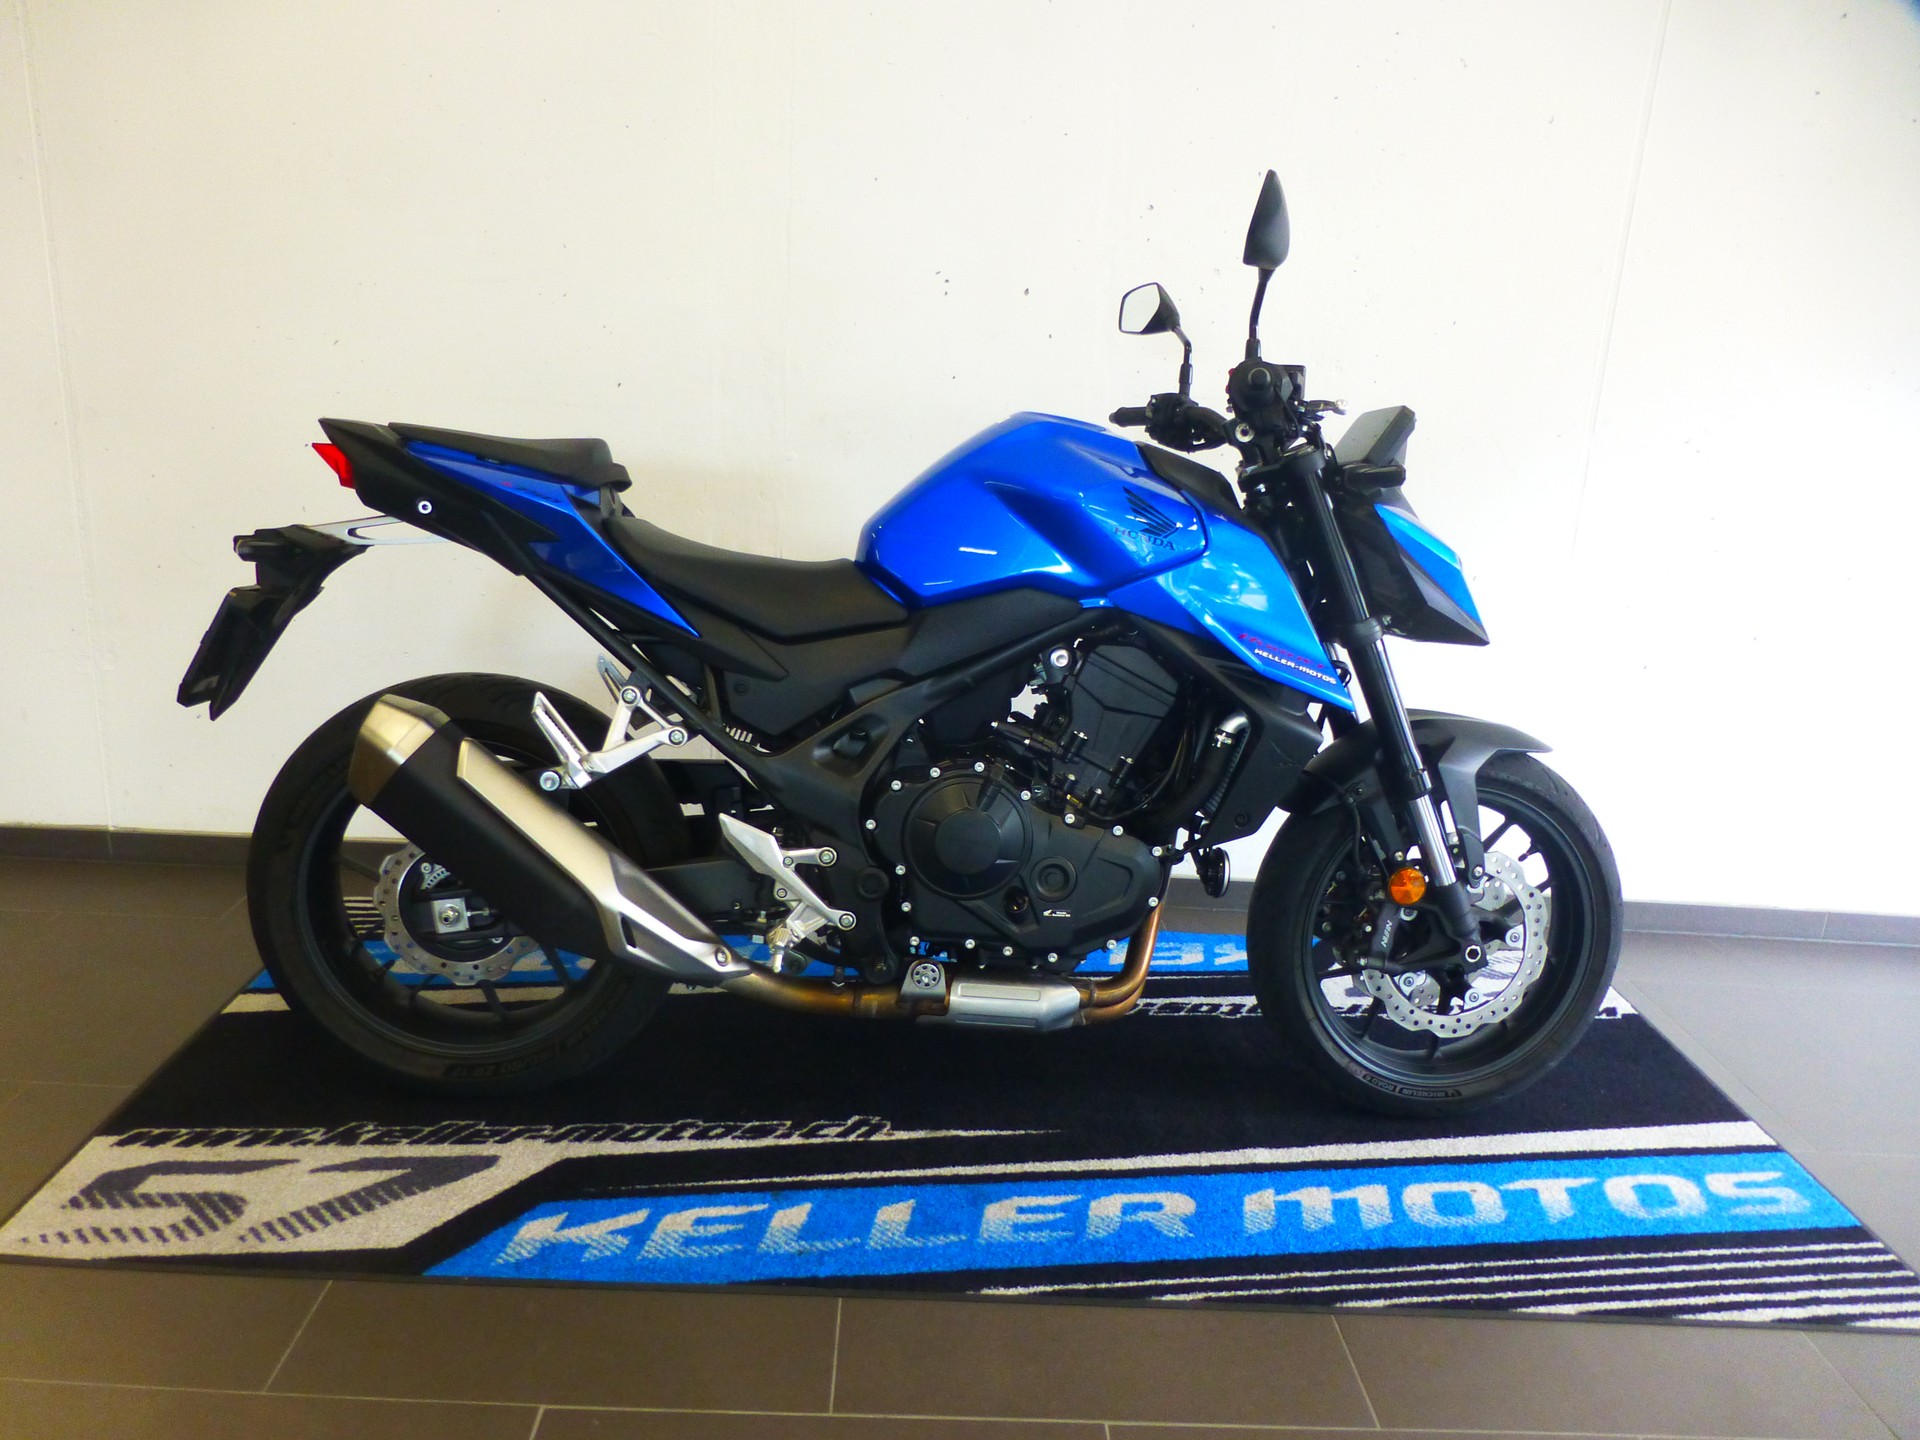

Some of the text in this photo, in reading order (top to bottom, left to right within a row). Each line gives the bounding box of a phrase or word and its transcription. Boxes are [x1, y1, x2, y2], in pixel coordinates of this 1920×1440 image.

[1114, 526, 1176, 552] HONDA
[1254, 648, 1338, 686] KELLER-MOTOS
[1371, 1078, 1395, 1093] ROAD
[1401, 1087, 1446, 1098] MICHELIN
[493, 1170, 1811, 1267] KELLER MOTOS
